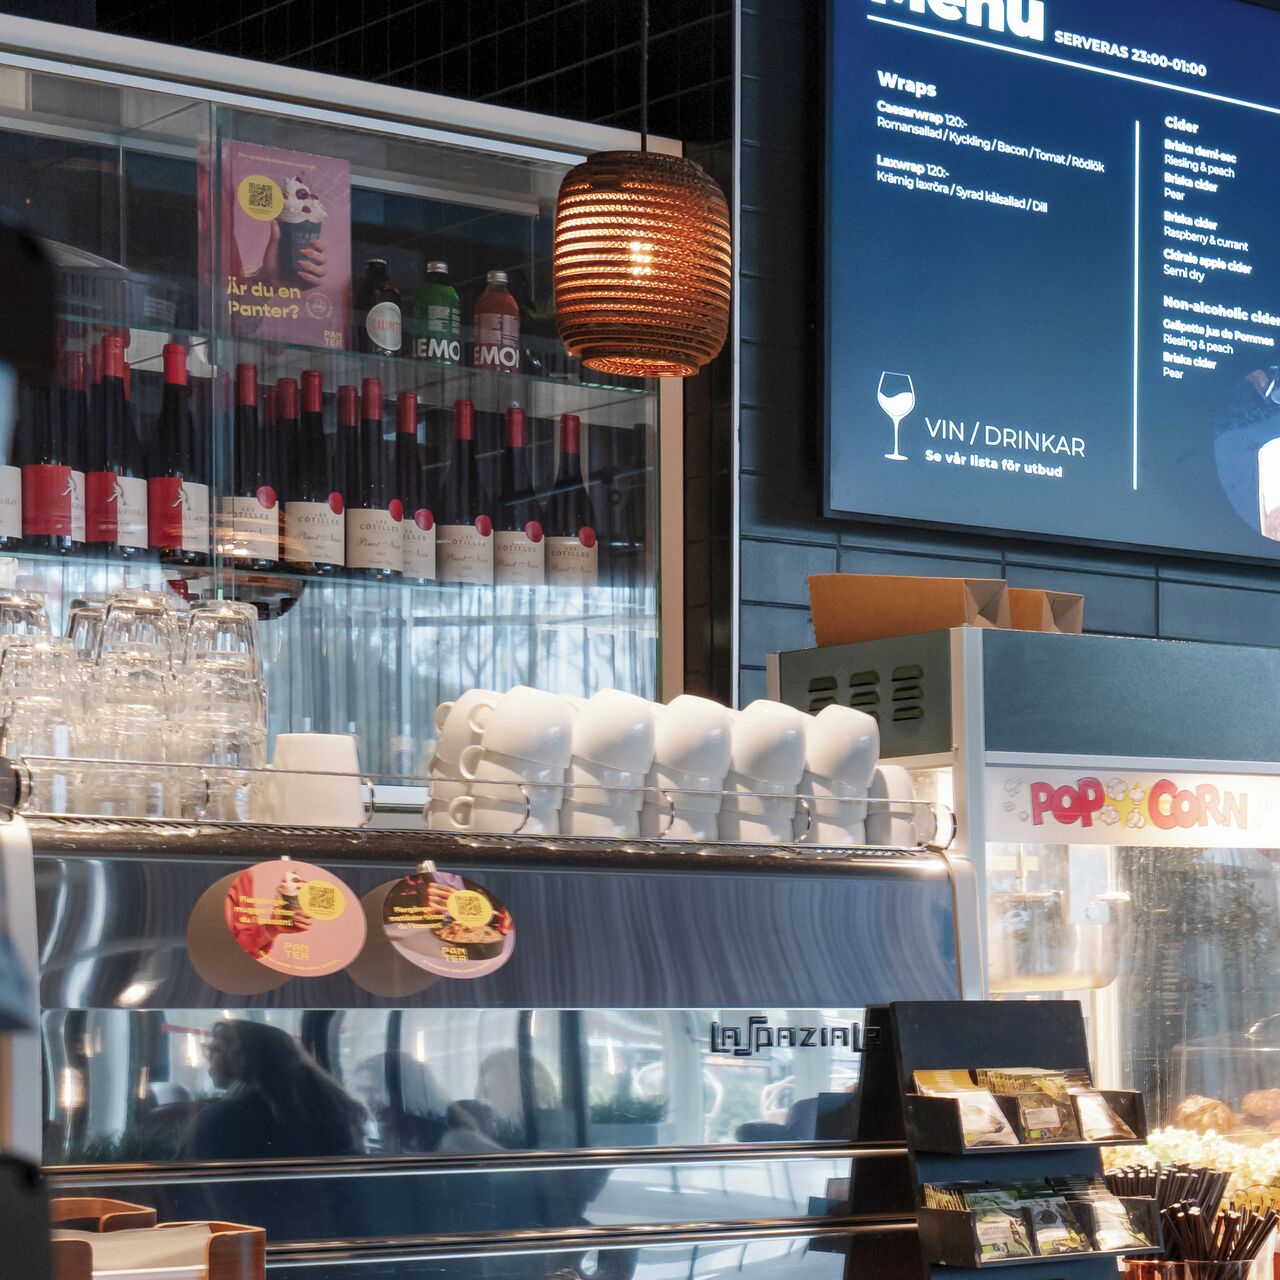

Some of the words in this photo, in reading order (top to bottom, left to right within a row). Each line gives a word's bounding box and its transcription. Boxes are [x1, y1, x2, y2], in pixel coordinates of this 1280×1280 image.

[871, 0, 1044, 41] enu
[1055, 30, 1129, 59] SERVERAS
[1131, 48, 1207, 77] 23:00-01:00
[878, 71, 936, 98] Wraps
[1165, 117, 1199, 133] Cider
[878, 116, 942, 139] Romansallad
[950, 131, 992, 151] Kyckling
[998, 141, 1028, 156] Bacon
[1034, 149, 1065, 164] Tomat
[1072, 157, 1104, 172] Rödlök
[1165, 154, 1199, 172] Riesling
[1208, 166, 1235, 178] peach
[877, 171, 914, 189] Krämig
[916, 178, 949, 194] laxröra
[956, 186, 983, 200] Syrad
[985, 191, 1025, 208] kålsallad
[1033, 202, 1047, 212] Dill
[1165, 187, 1185, 200] Pear
[1164, 226, 1208, 245] Raspberry
[1217, 238, 1248, 251] currant
[1164, 264, 1187, 278] Semi
[1189, 269, 1205, 283] dry
[226, 276, 247, 296] Är
[251, 281, 273, 297] du
[278, 287, 301, 298] en
[228, 300, 299, 319] Panter?
[1164, 296, 1248, 320] Non-alcoholic
[1164, 334, 1197, 350] Riesling
[1207, 343, 1233, 354] peach
[1163, 367, 1183, 378] Pear
[925, 417, 965, 442] VIN
[985, 425, 1085, 458] DRINKAR
[925, 450, 942, 462] Se
[945, 451, 966, 466] vår
[970, 454, 998, 470] lista
[1001, 458, 1021, 473] för
[1024, 462, 1062, 478] utbud
[1030, 777, 1105, 827] POP
[1147, 779, 1248, 829] CORN
